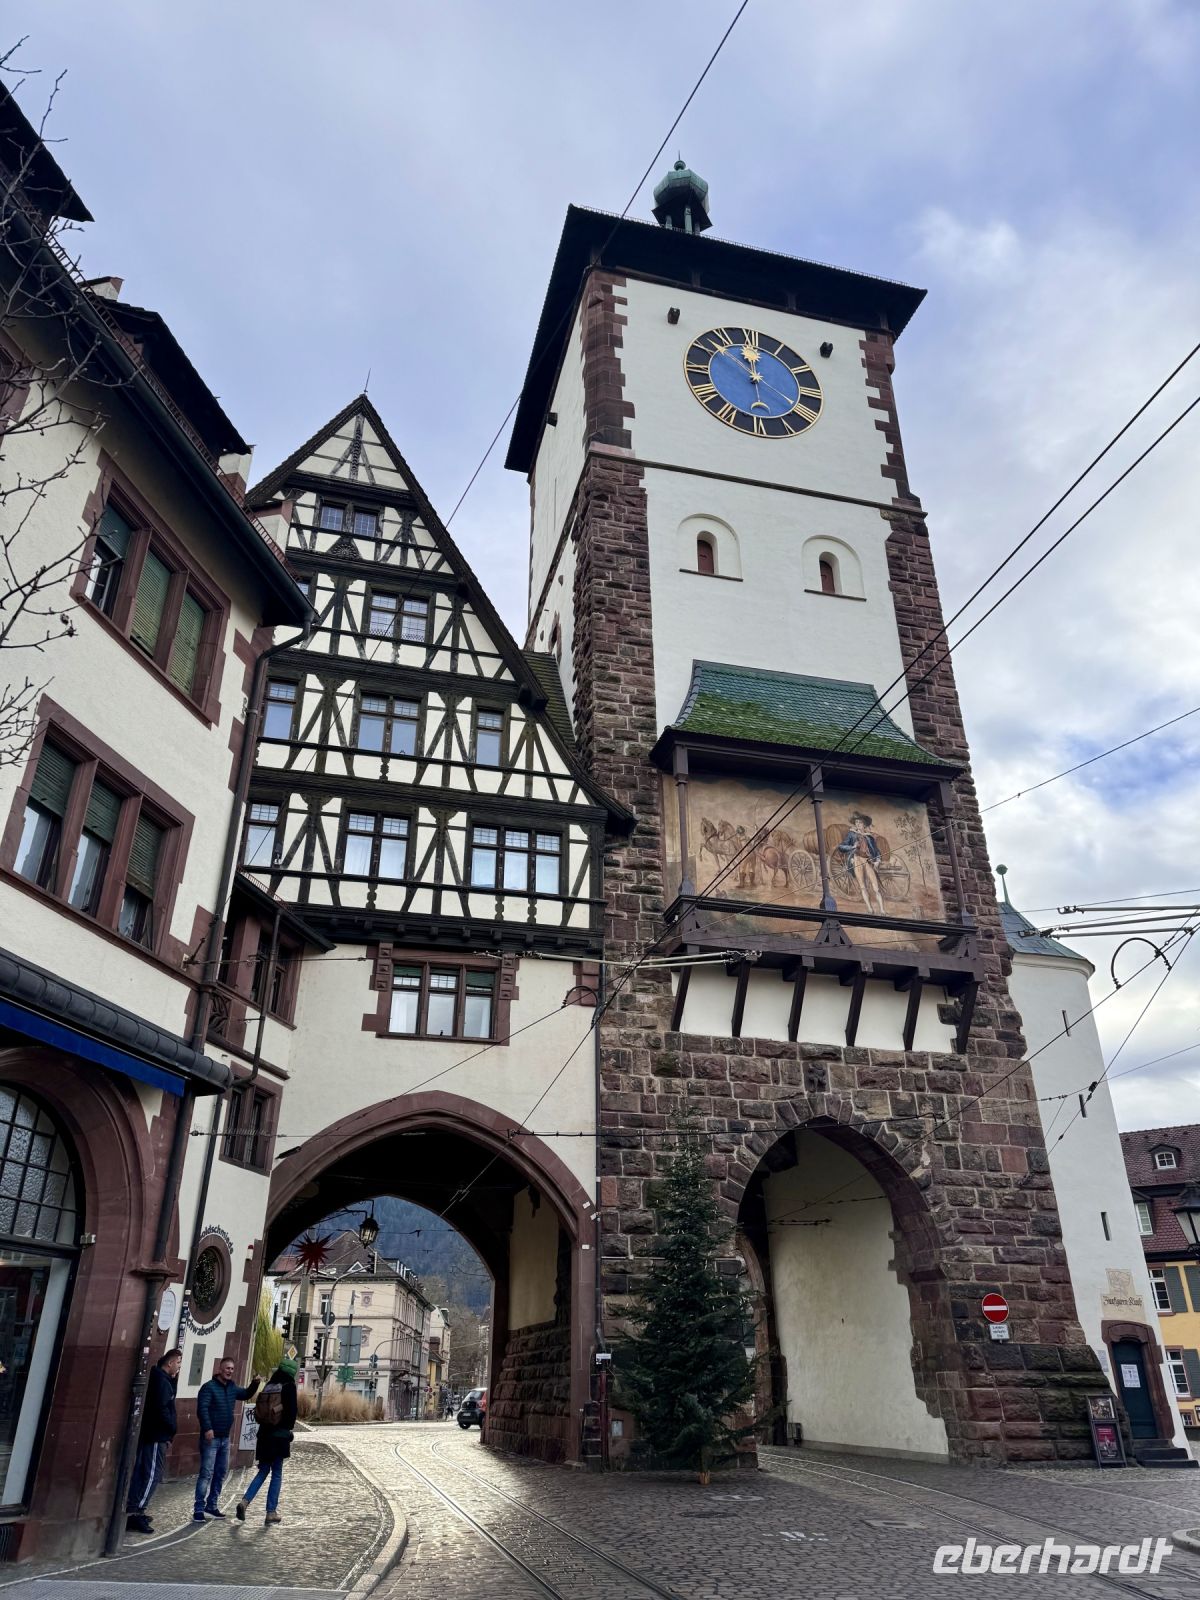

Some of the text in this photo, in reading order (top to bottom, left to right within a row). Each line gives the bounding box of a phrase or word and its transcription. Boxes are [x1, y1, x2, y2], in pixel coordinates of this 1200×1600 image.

[713, 327, 733, 346] XI
[774, 343, 785, 356] I
[790, 364, 811, 374] II
[799, 386, 822, 399] III
[780, 416, 796, 435] V
[200, 1224, 234, 1255] oldschmiede
